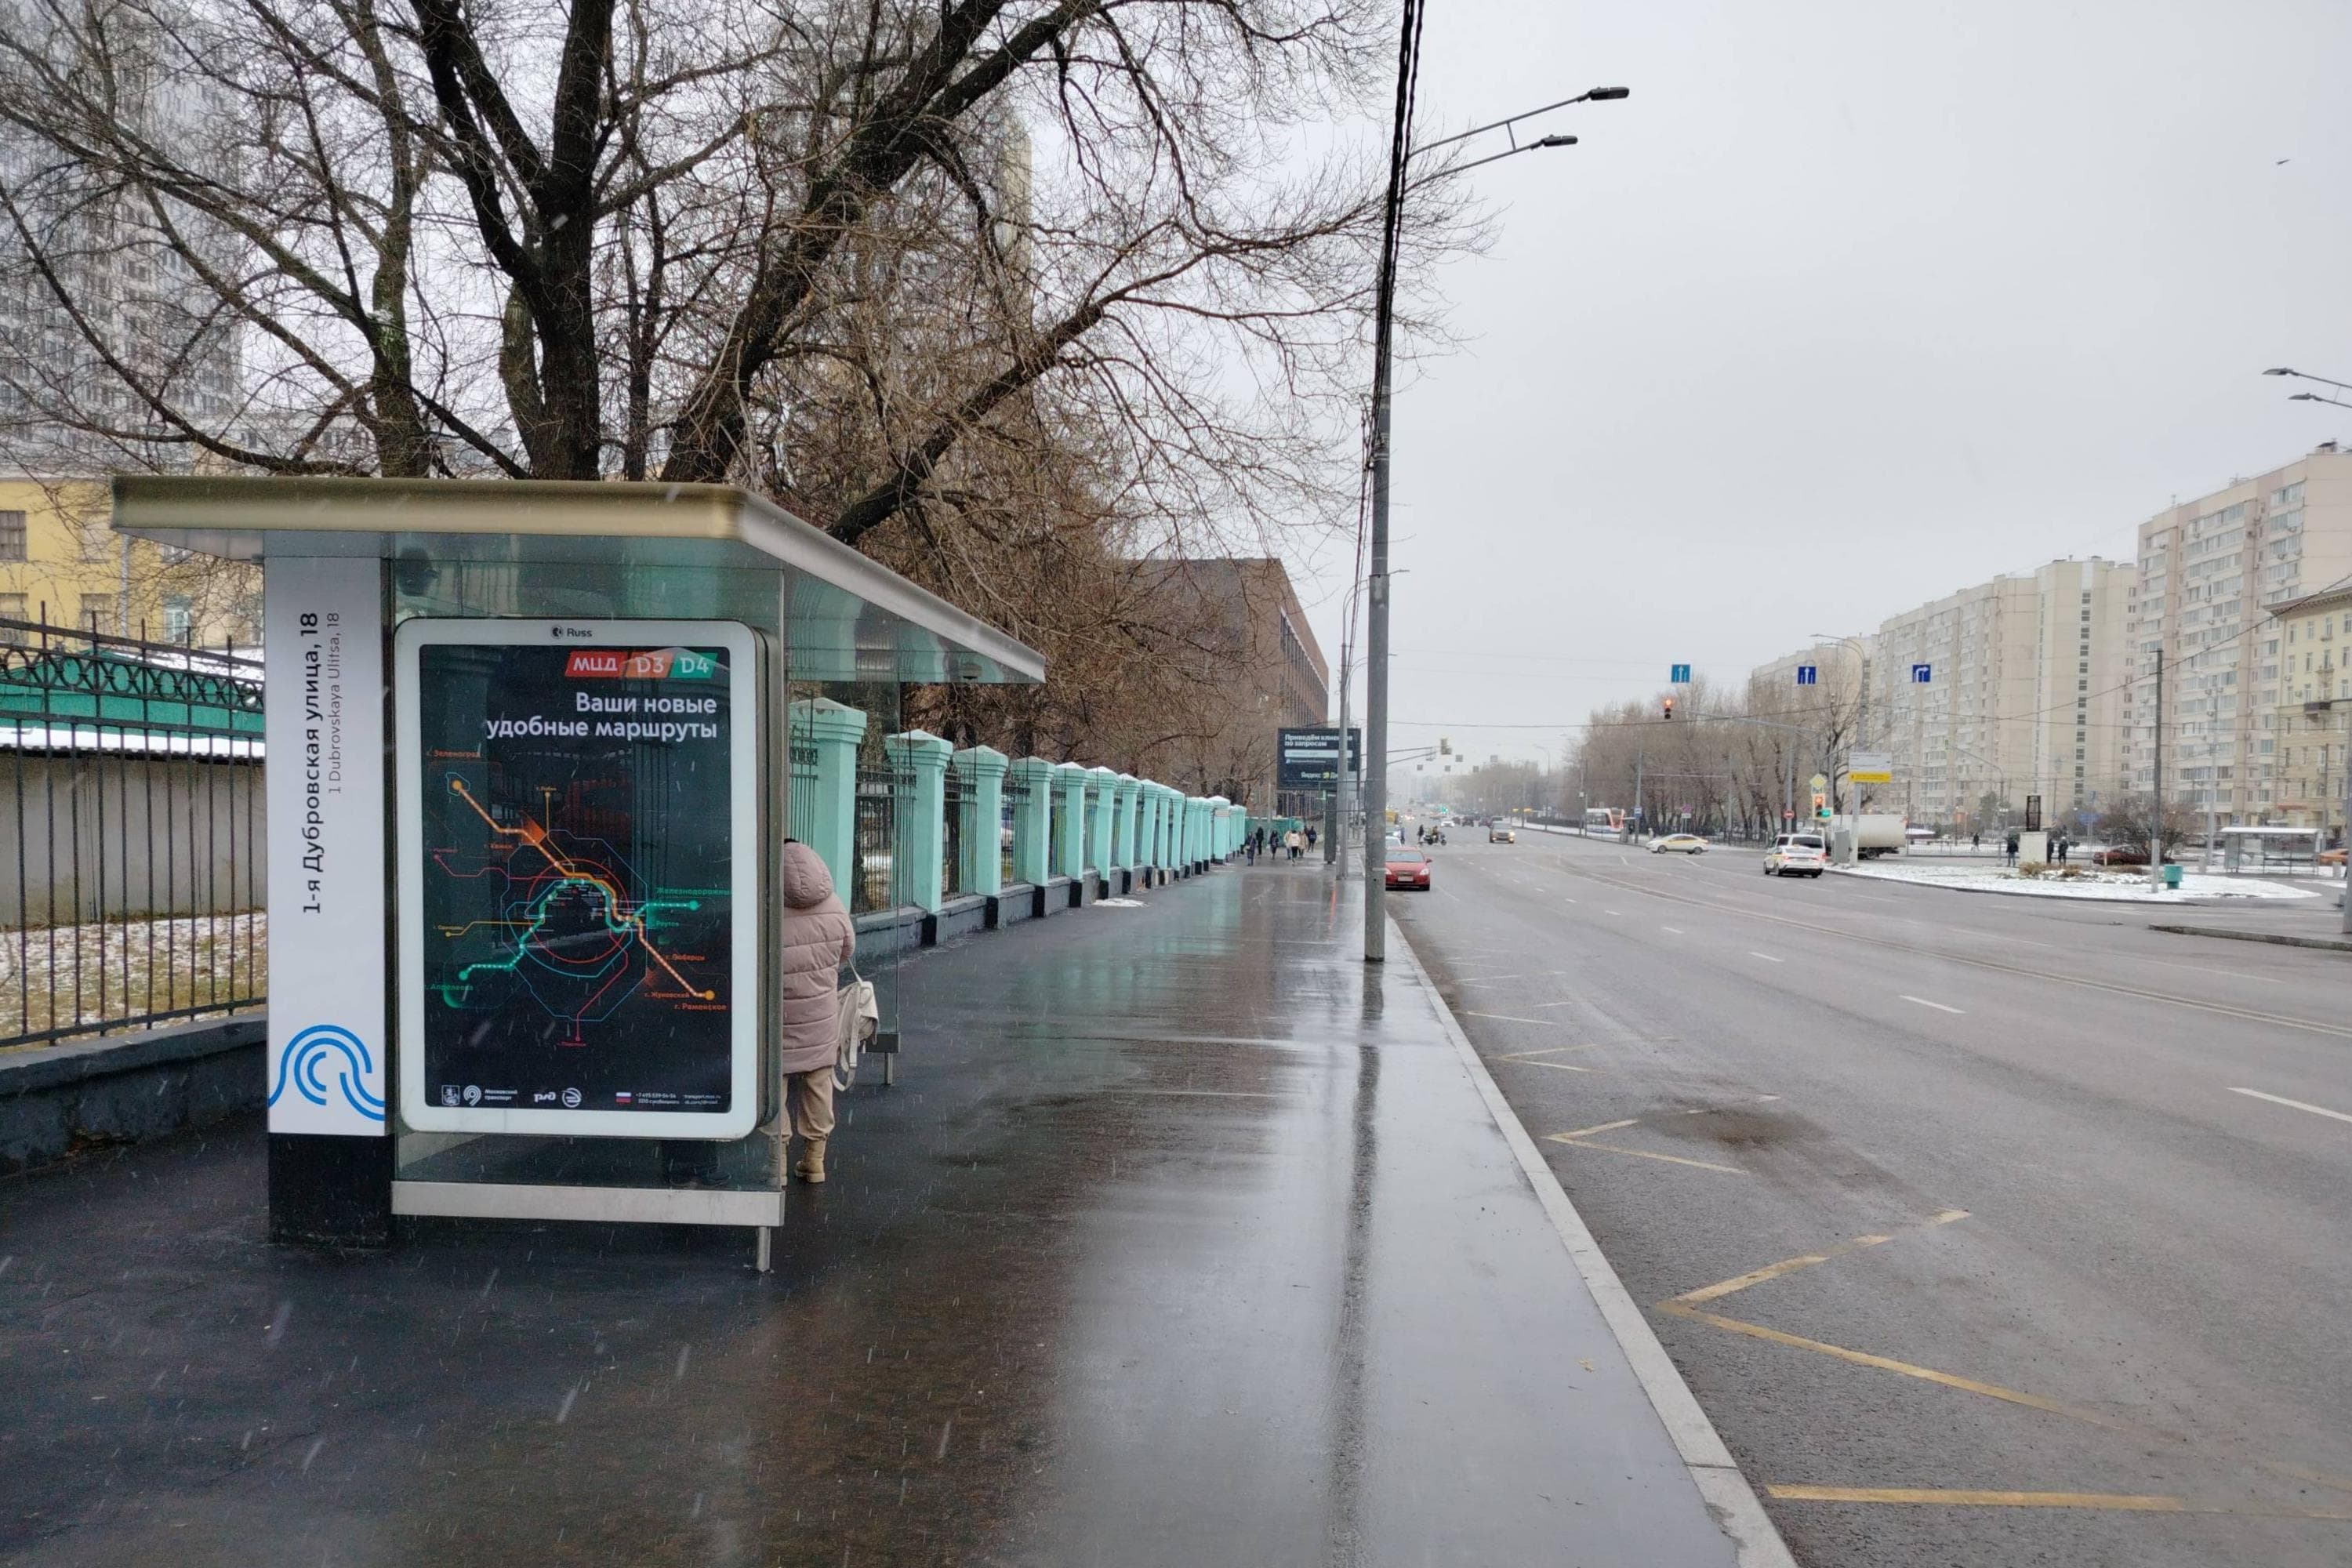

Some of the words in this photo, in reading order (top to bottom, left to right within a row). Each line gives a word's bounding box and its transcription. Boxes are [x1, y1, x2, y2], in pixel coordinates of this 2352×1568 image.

[300, 613, 318, 637] 18
[327, 612, 339, 628] 18
[567, 628, 592, 637] Russ
[328, 633, 342, 679] Ulitsa,
[573, 657, 618, 671] МЦД
[637, 657, 664, 673] D3
[680, 657, 709, 673] D4
[305, 644, 323, 721] улица,
[575, 692, 637, 712] Ваши
[644, 699, 717, 713] новые
[328, 684, 343, 782] Dubrovskaya
[487, 715, 588, 739] удобные
[595, 723, 717, 742] маршруты
[302, 728, 324, 873] Дубровская
[303, 880, 321, 913] 1-я
